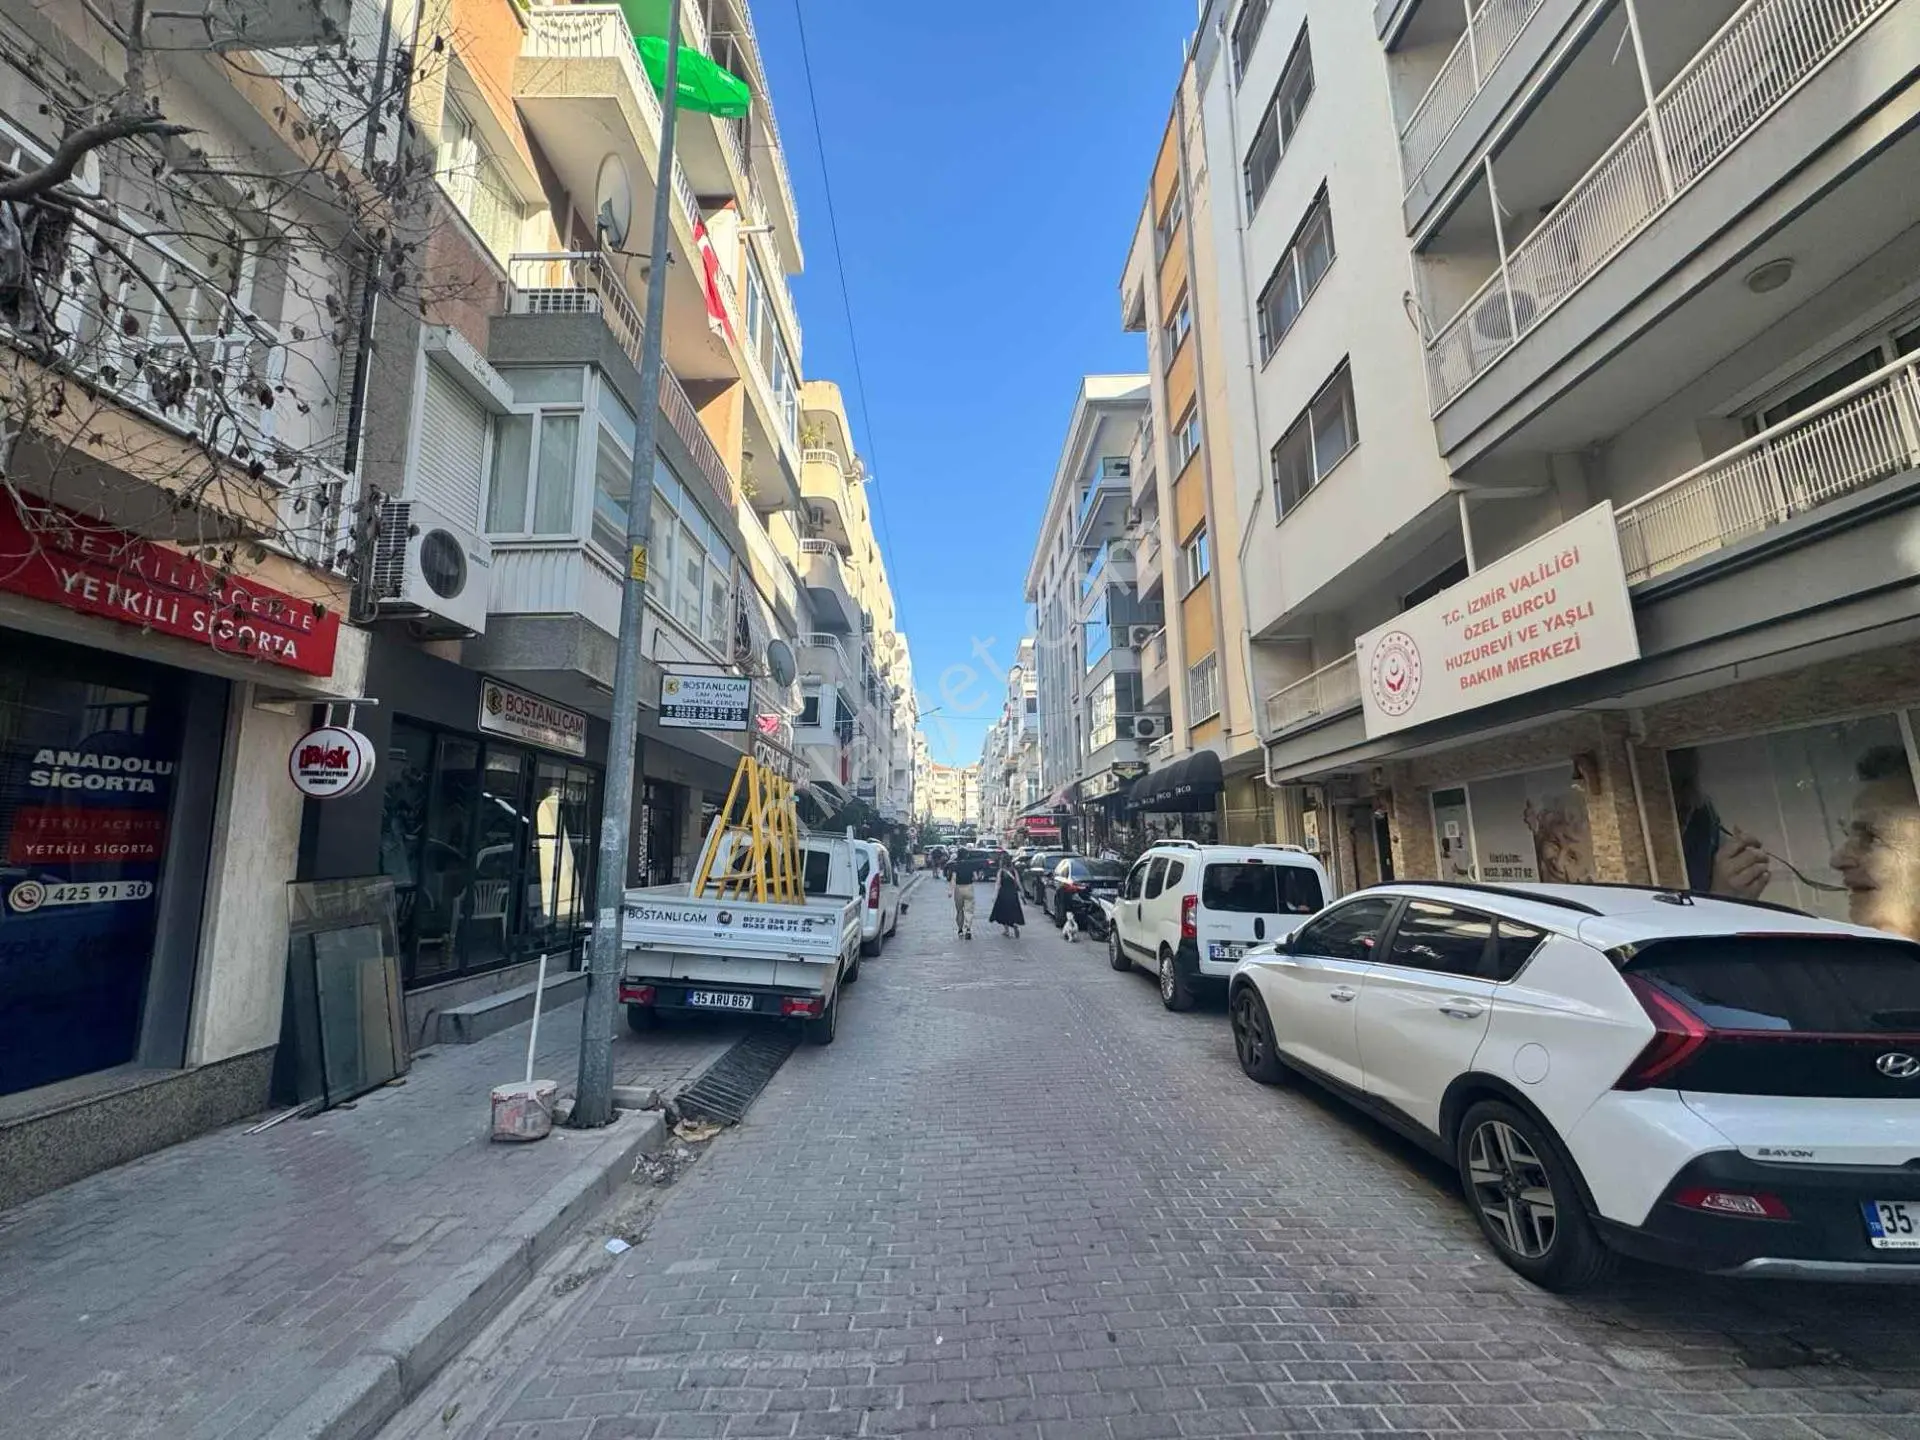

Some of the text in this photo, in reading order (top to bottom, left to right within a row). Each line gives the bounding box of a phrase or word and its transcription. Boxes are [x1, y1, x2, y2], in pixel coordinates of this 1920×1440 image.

[61, 567, 180, 624] YETKİLİ
[1441, 545, 1580, 627] T.C. İZMİR VALİLİĞİ
[1464, 588, 1557, 641] ÖZEL BURCU
[1445, 600, 1594, 672] HUZUREVİ VE YAŞLI
[1460, 631, 1581, 690] BAKIM MERKEZİ
[683, 680, 747, 693] BOSTANLI CAM
[506, 694, 561, 727] BOSTANLI
[562, 712, 584, 735] CAM
[33, 749, 173, 776] ANADOLU
[29, 767, 155, 793] SİGORTA
[26, 840, 155, 857] YETKİLİ SİGORTA
[54, 883, 147, 901] 425 91 30
[628, 908, 682, 922] BOSTANLI
[683, 912, 708, 924] CAM
[694, 992, 751, 1008] 35 ARU 867
[1758, 1148, 1813, 1158] BAYON
[1879, 1204, 1913, 1234] 35
